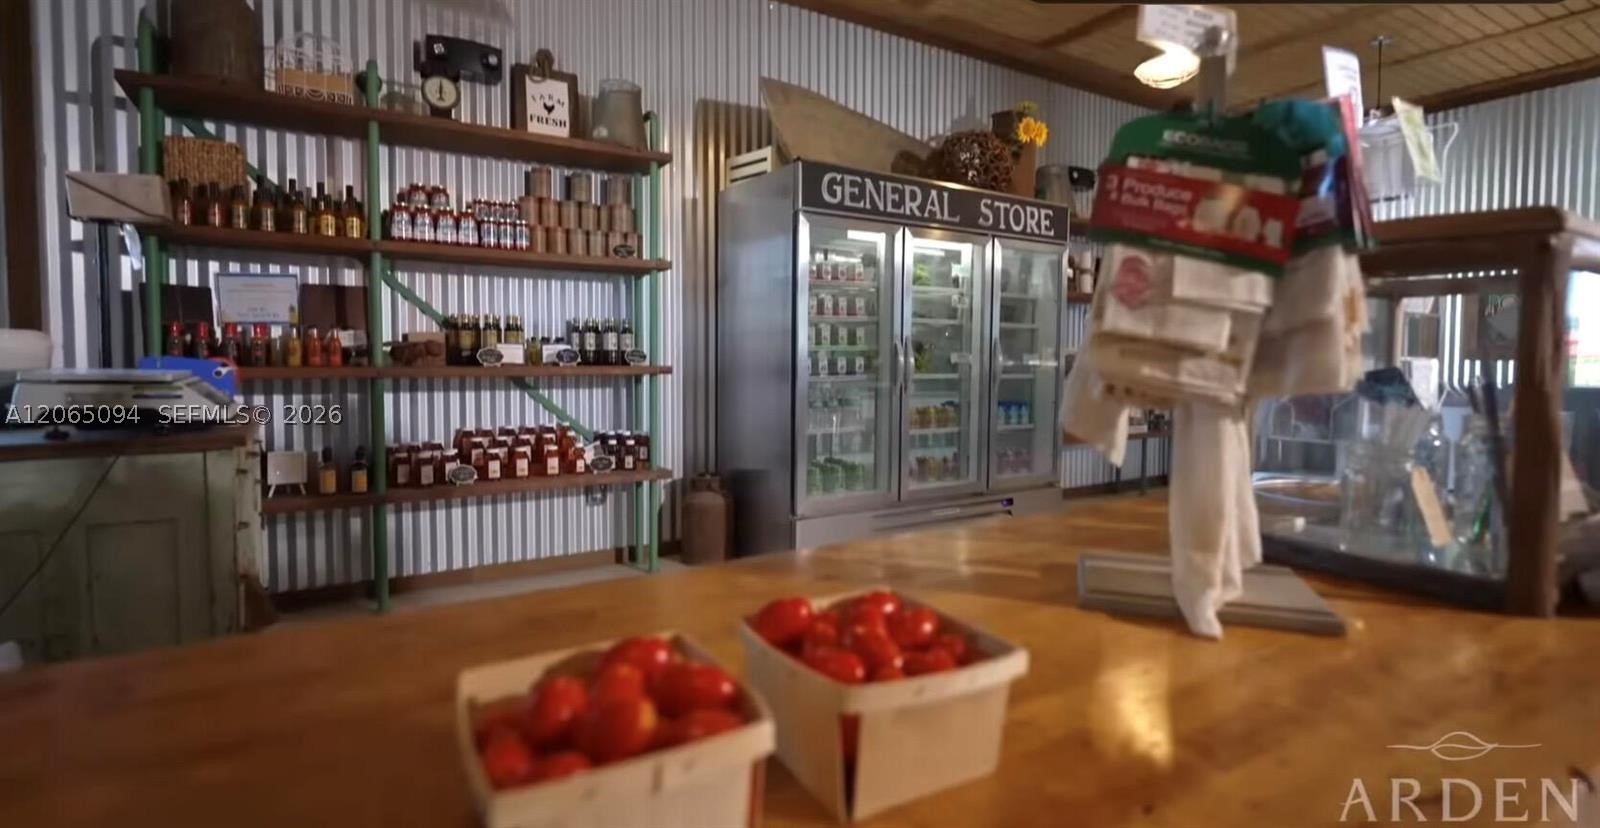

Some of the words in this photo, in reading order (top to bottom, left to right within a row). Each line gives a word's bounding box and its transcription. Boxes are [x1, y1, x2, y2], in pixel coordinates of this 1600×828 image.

[529, 113, 567, 128] FRESH
[1122, 177, 1194, 202] Produce
[821, 172, 960, 223] GENERAL
[978, 198, 1054, 236] STORE
